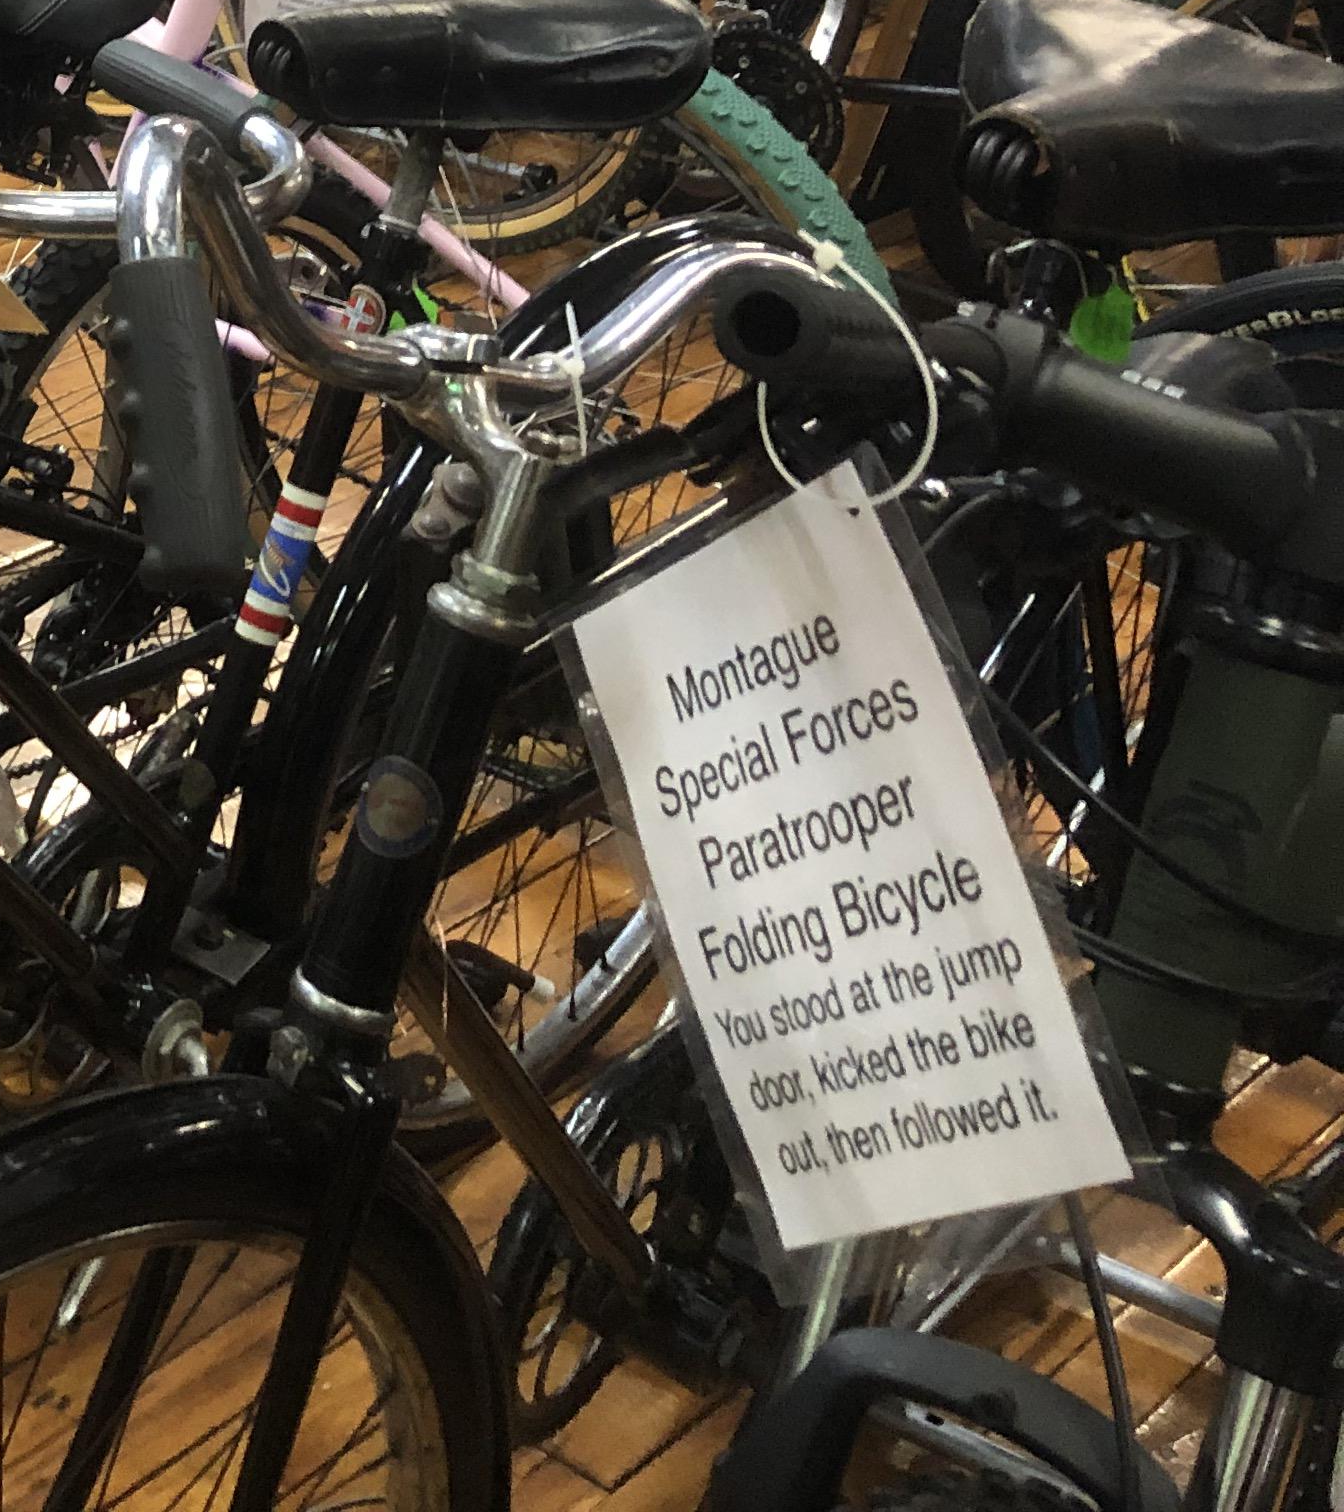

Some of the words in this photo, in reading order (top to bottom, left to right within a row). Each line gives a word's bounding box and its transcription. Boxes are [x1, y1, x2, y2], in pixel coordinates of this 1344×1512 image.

[667, 614, 841, 724] Montague
[655, 724, 778, 823] Special
[782, 677, 920, 765] Forces
[698, 774, 916, 890] Paratrooper
[698, 902, 833, 981] Folding
[833, 850, 983, 939] Bicycle
[715, 1006, 768, 1049] You
[775, 981, 844, 1039] stood
[850, 973, 882, 1015] at
[887, 956, 935, 1007] the
[940, 936, 1023, 1001] jump
[749, 1068, 816, 1114] door,
[811, 1041, 907, 1095] kicked
[911, 1025, 960, 1072] the
[967, 1005, 1035, 1059] bike
[778, 1133, 831, 1178] out,
[831, 1116, 892, 1164] then
[890, 1083, 1021, 1148] followed
[1024, 1078, 1060, 1125] it.
